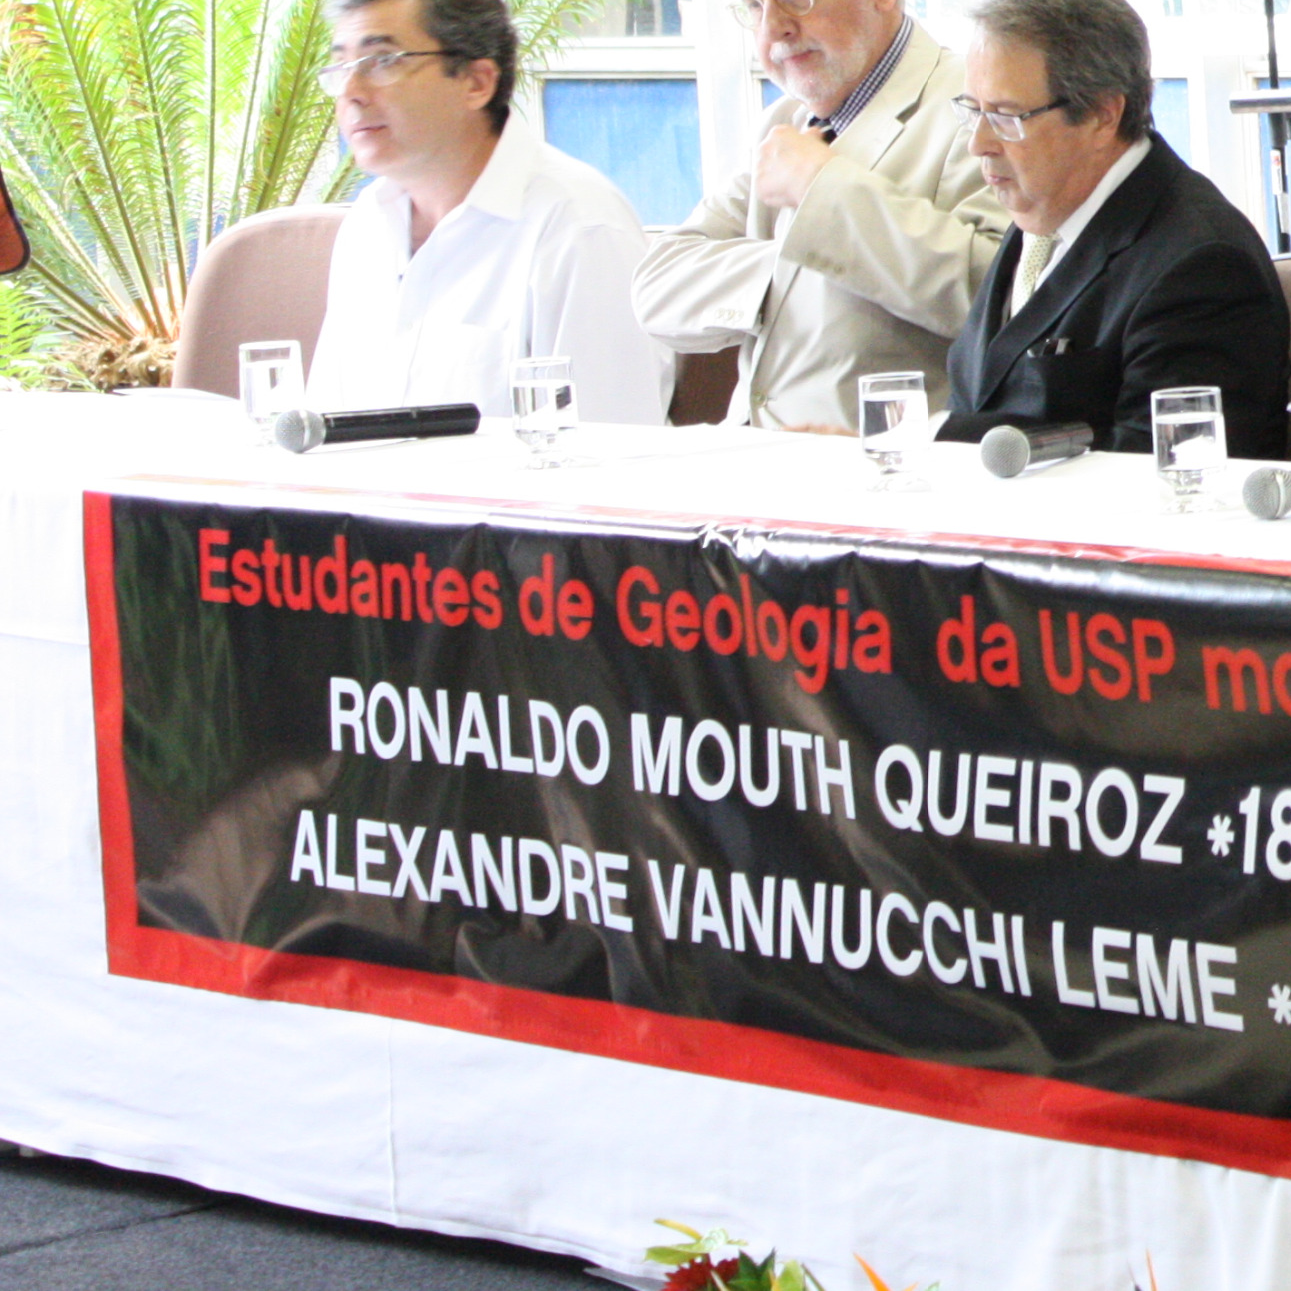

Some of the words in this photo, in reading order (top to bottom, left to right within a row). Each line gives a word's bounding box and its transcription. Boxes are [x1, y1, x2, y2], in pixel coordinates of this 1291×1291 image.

[199, 526, 502, 631] Estudantes
[519, 555, 593, 643] de
[616, 564, 892, 692] Geologia
[936, 595, 1017, 690] da
[1038, 608, 1175, 704] USP
[329, 677, 611, 787] RONALDO
[632, 712, 856, 820] MOUTH
[873, 743, 1186, 865] QUEIROZ
[289, 810, 634, 932] ALEXANDRE
[647, 861, 1031, 998] VANNUCCHI
[1050, 919, 1245, 1033] LEME
